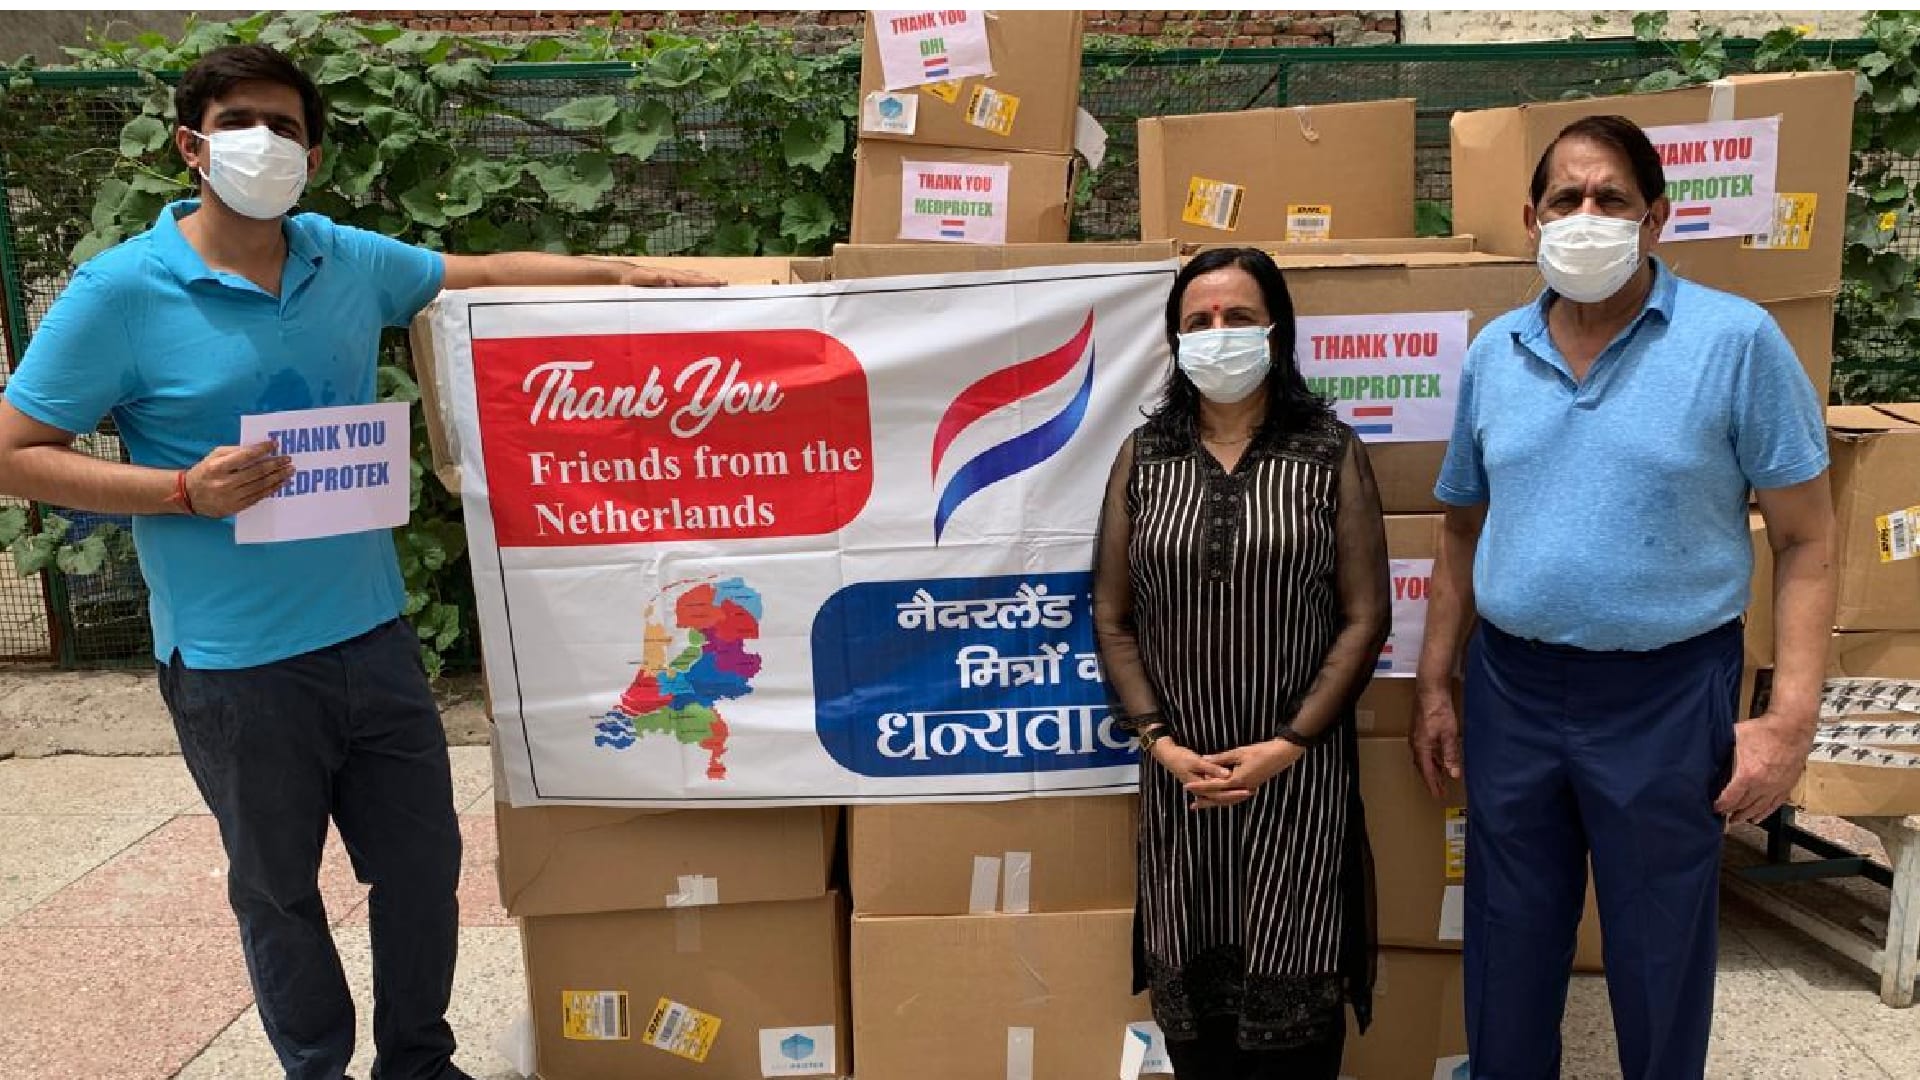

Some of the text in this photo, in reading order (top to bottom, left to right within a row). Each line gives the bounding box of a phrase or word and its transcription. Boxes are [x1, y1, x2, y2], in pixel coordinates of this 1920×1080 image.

[890, 10, 967, 35] THANK YOU
[920, 37, 947, 57] DHL
[1653, 137, 1753, 167] HANK YOU
[918, 173, 993, 193] THANK YOU
[1665, 174, 1754, 203] DPROTEX
[914, 198, 993, 217] MEDPROTEX
[1310, 332, 1439, 361] THANK YOU
[522, 356, 785, 438] Thank You
[1306, 373, 1442, 401] MEDPROTEX
[267, 420, 386, 456] THANK YOU
[527, 440, 863, 486] Friends from the
[534, 494, 777, 537] Netherlands
[896, 582, 1076, 632] नैदरलैंड
[955, 642, 1070, 688] मित्रों
